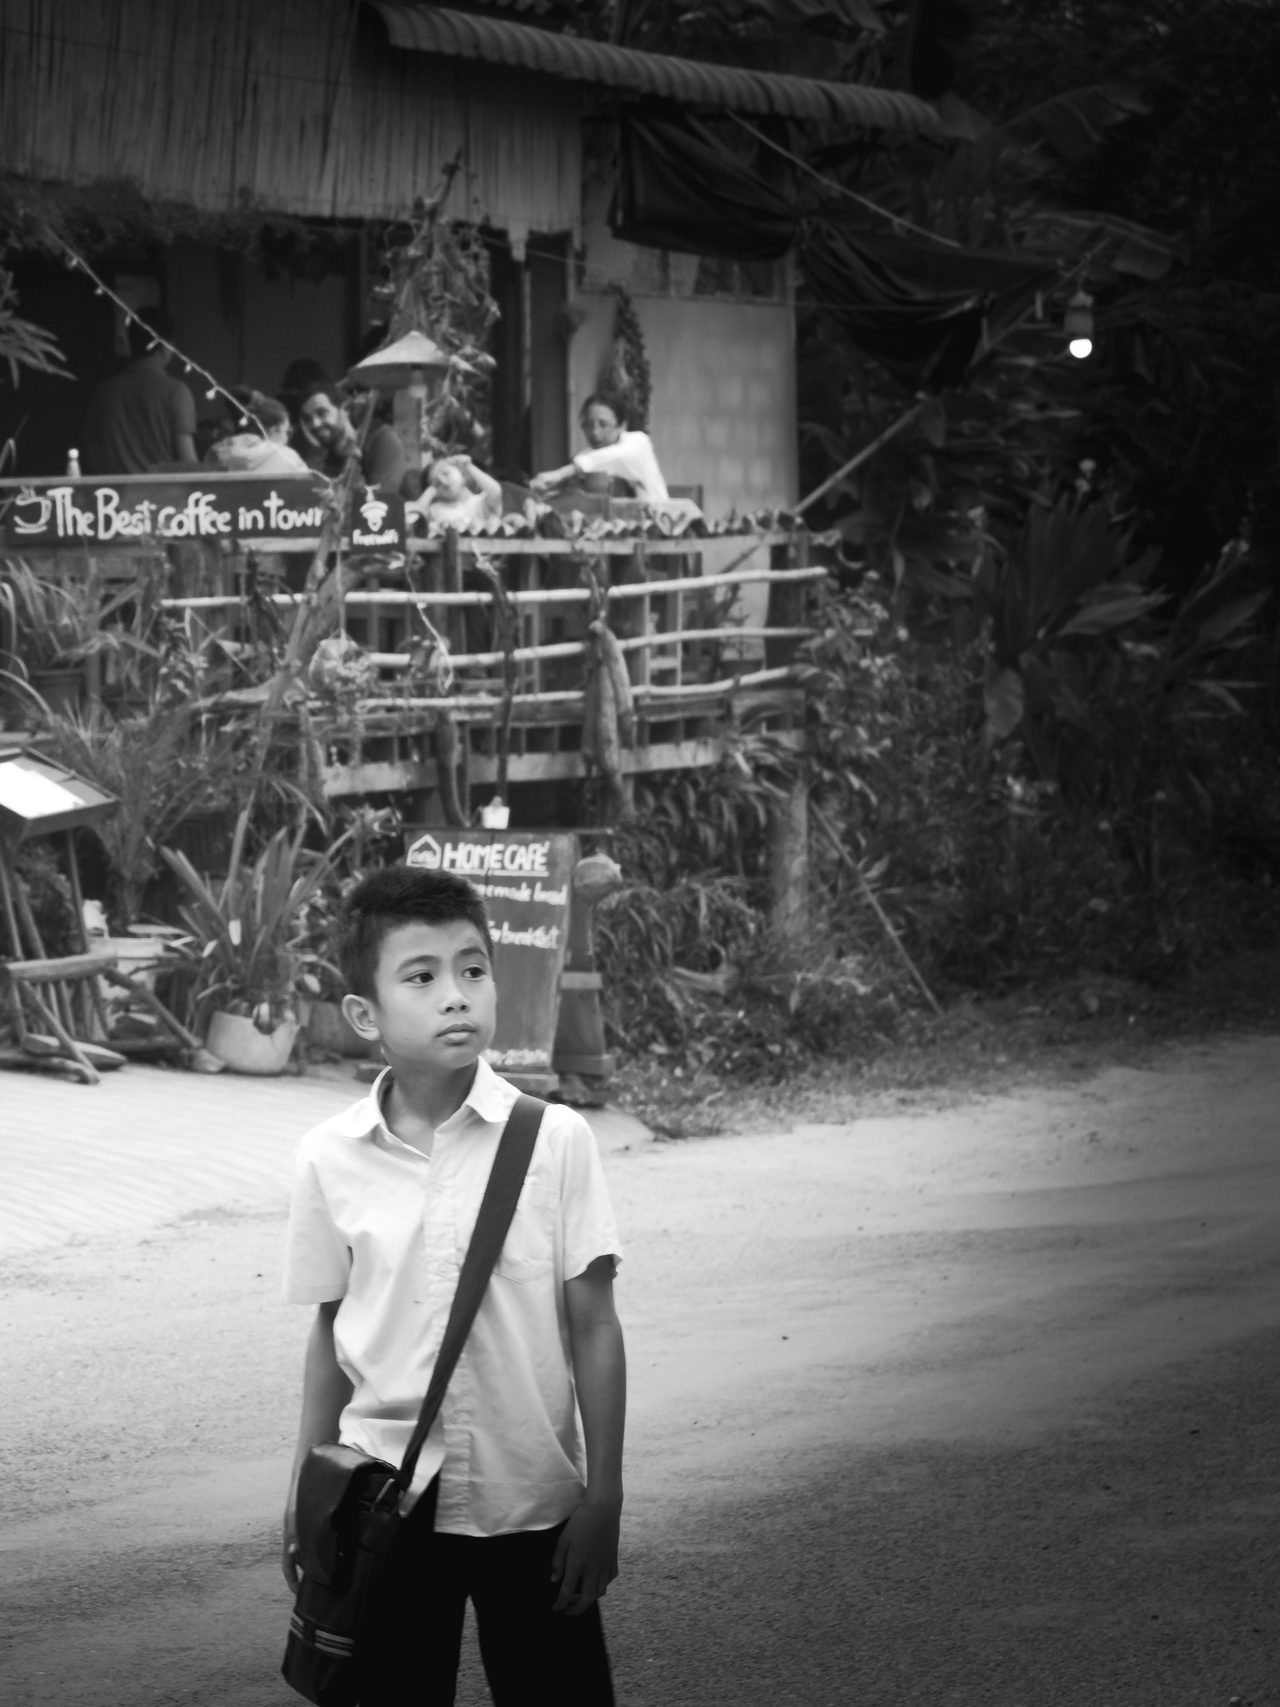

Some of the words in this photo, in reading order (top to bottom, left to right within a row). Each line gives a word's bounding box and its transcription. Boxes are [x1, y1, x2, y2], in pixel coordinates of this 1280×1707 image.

[46, 487, 95, 538] The
[94, 488, 157, 541] Best
[237, 507, 265, 531] in
[442, 842, 504, 871] HOME
